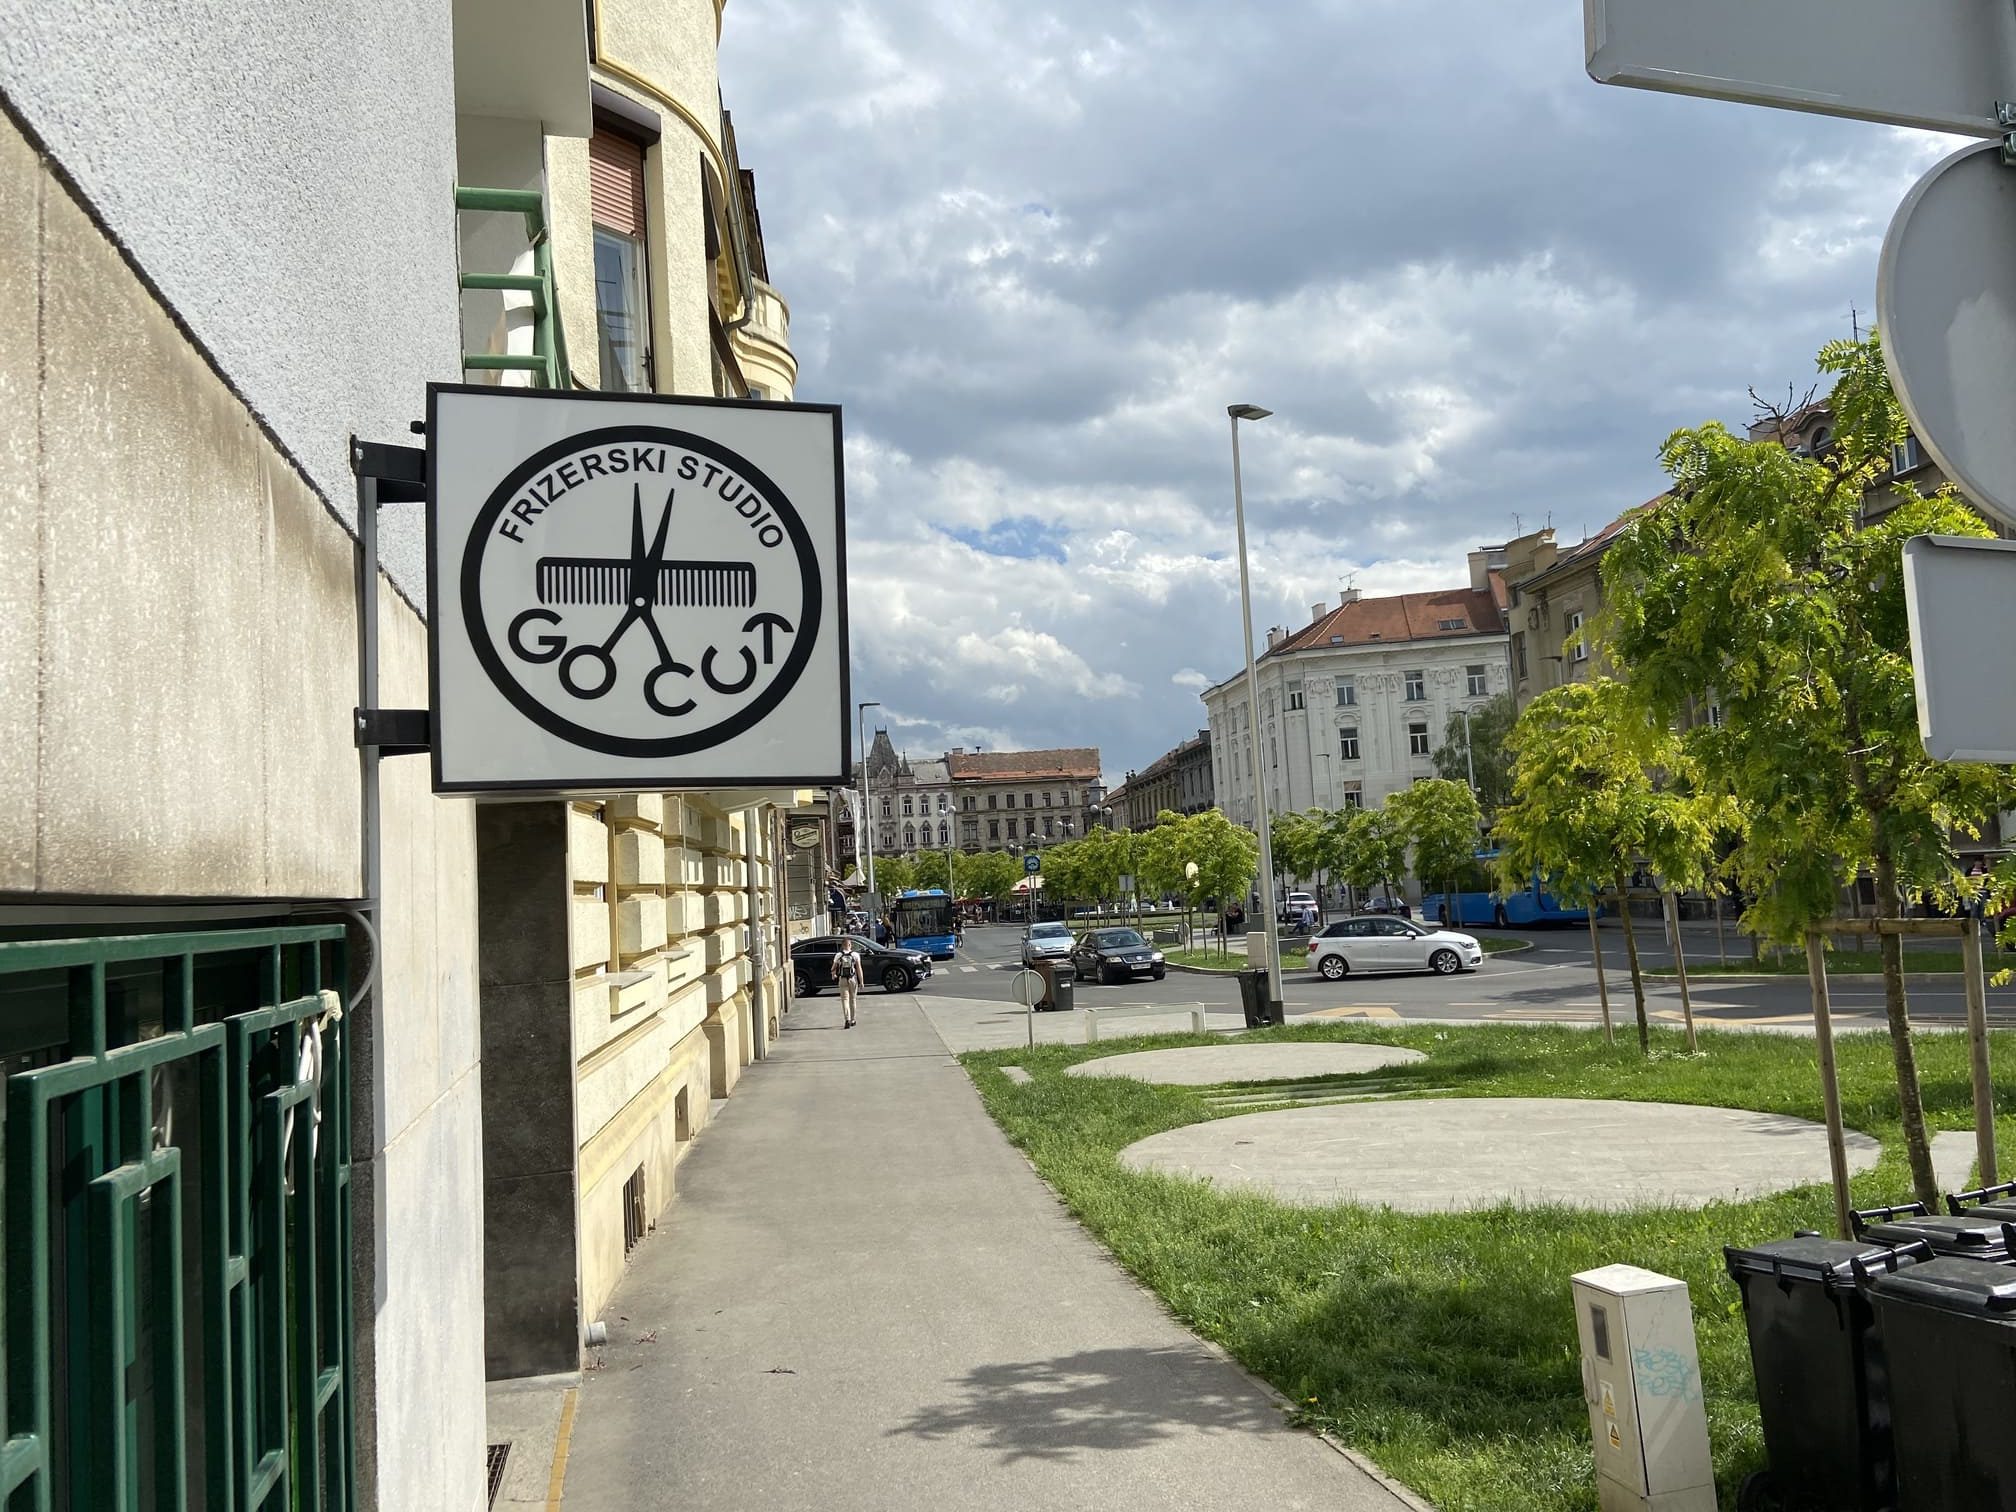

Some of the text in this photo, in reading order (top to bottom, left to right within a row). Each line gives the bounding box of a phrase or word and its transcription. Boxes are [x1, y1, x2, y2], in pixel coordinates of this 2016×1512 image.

[498, 447, 784, 548] FRIZERSKI STUDIO
[507, 608, 795, 717] GO CUT
